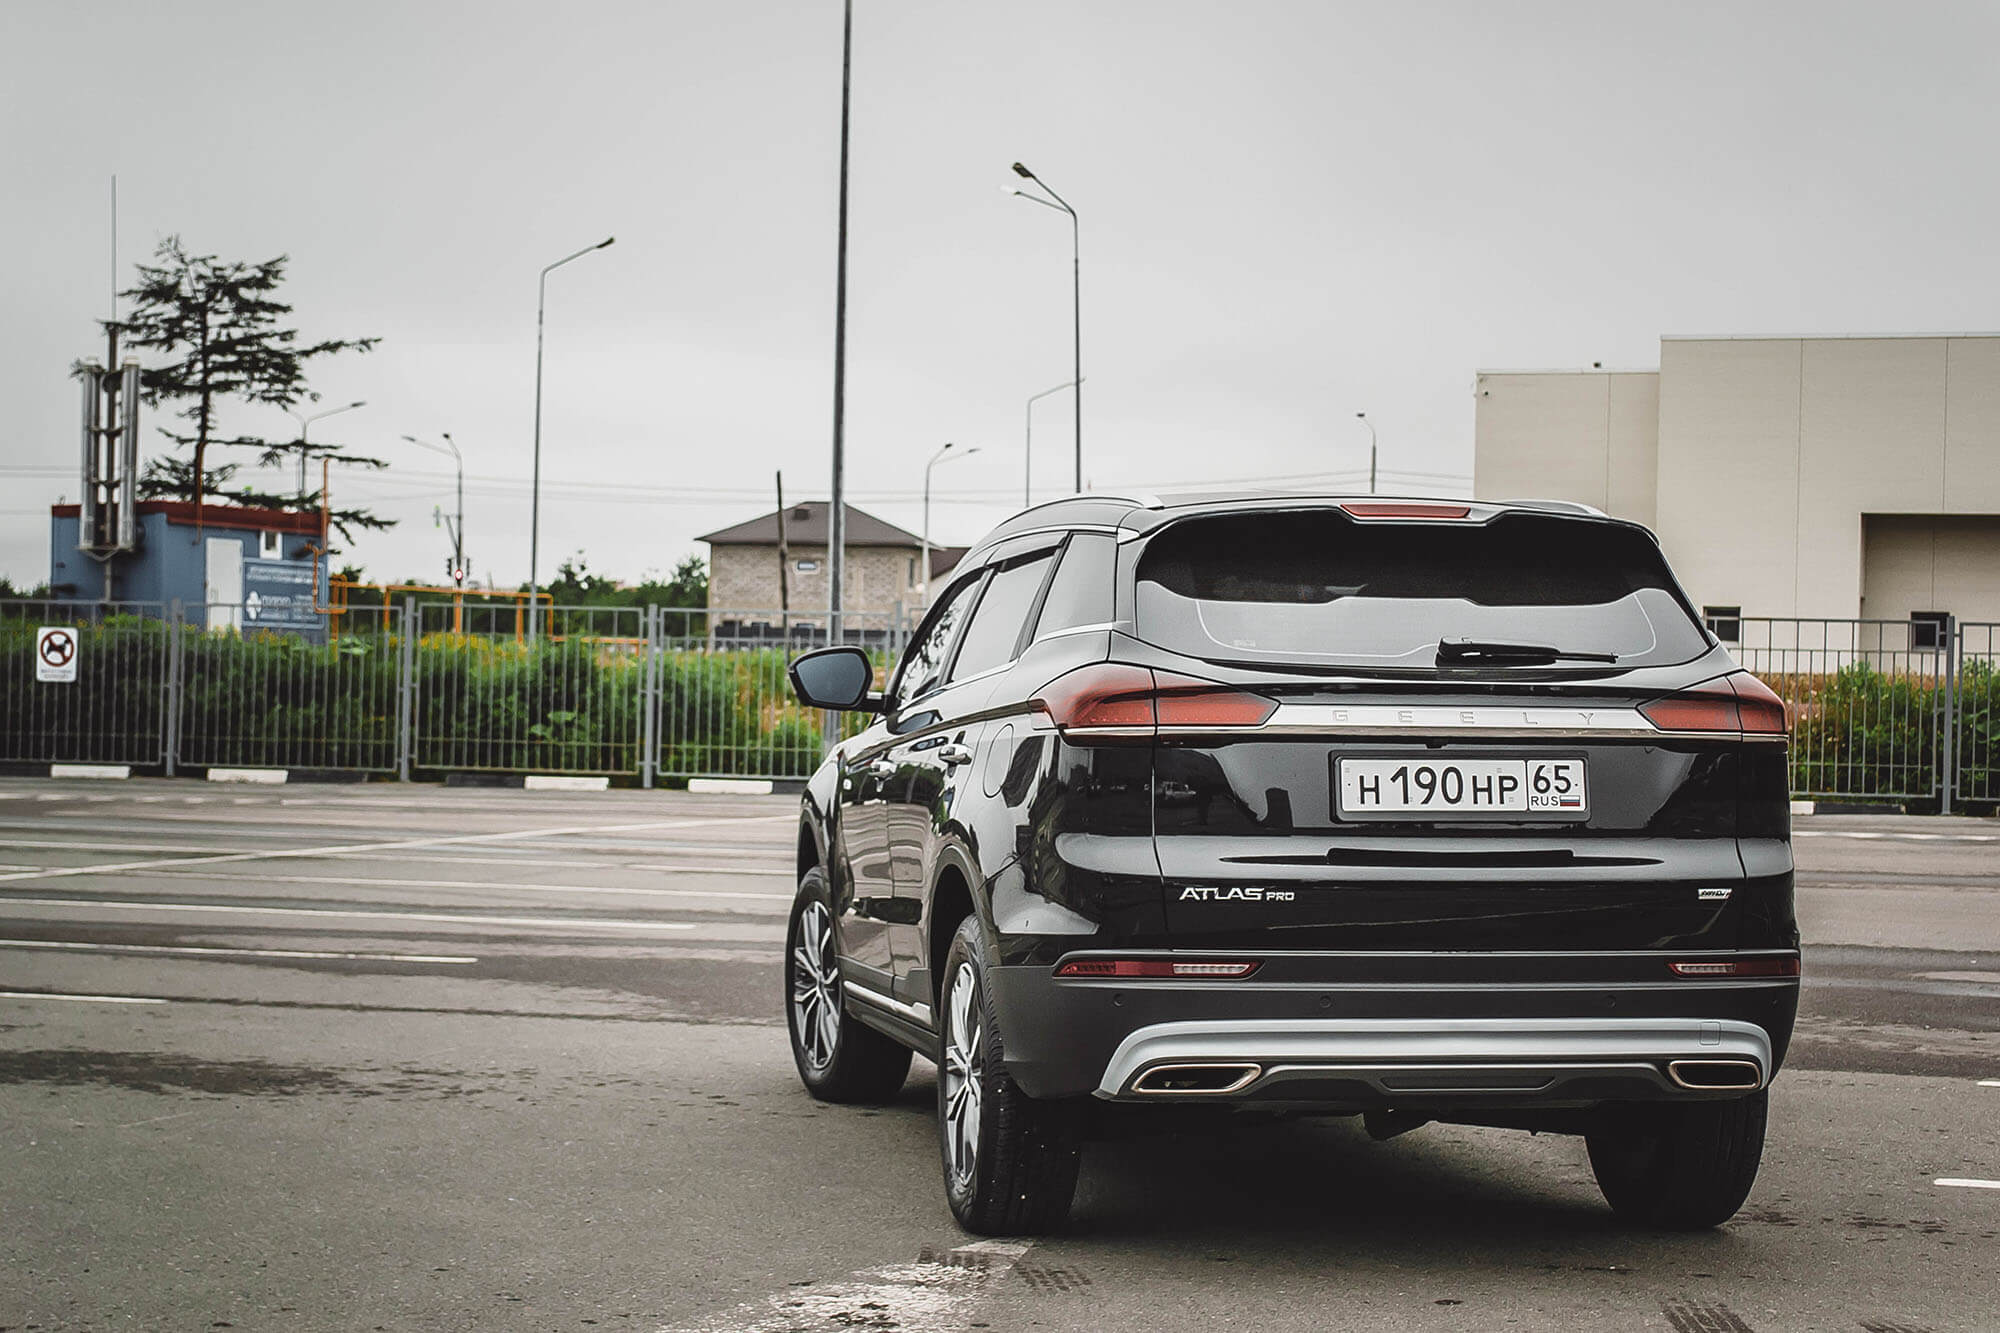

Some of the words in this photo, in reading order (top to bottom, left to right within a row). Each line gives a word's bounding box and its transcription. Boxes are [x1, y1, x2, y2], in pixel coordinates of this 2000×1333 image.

[1332, 709, 1594, 726] GEELY
[1533, 764, 1572, 794] 65
[1531, 796, 1559, 807] RUS
[1179, 887, 1265, 901] ATLAS
[1265, 891, 1295, 901] PRO
